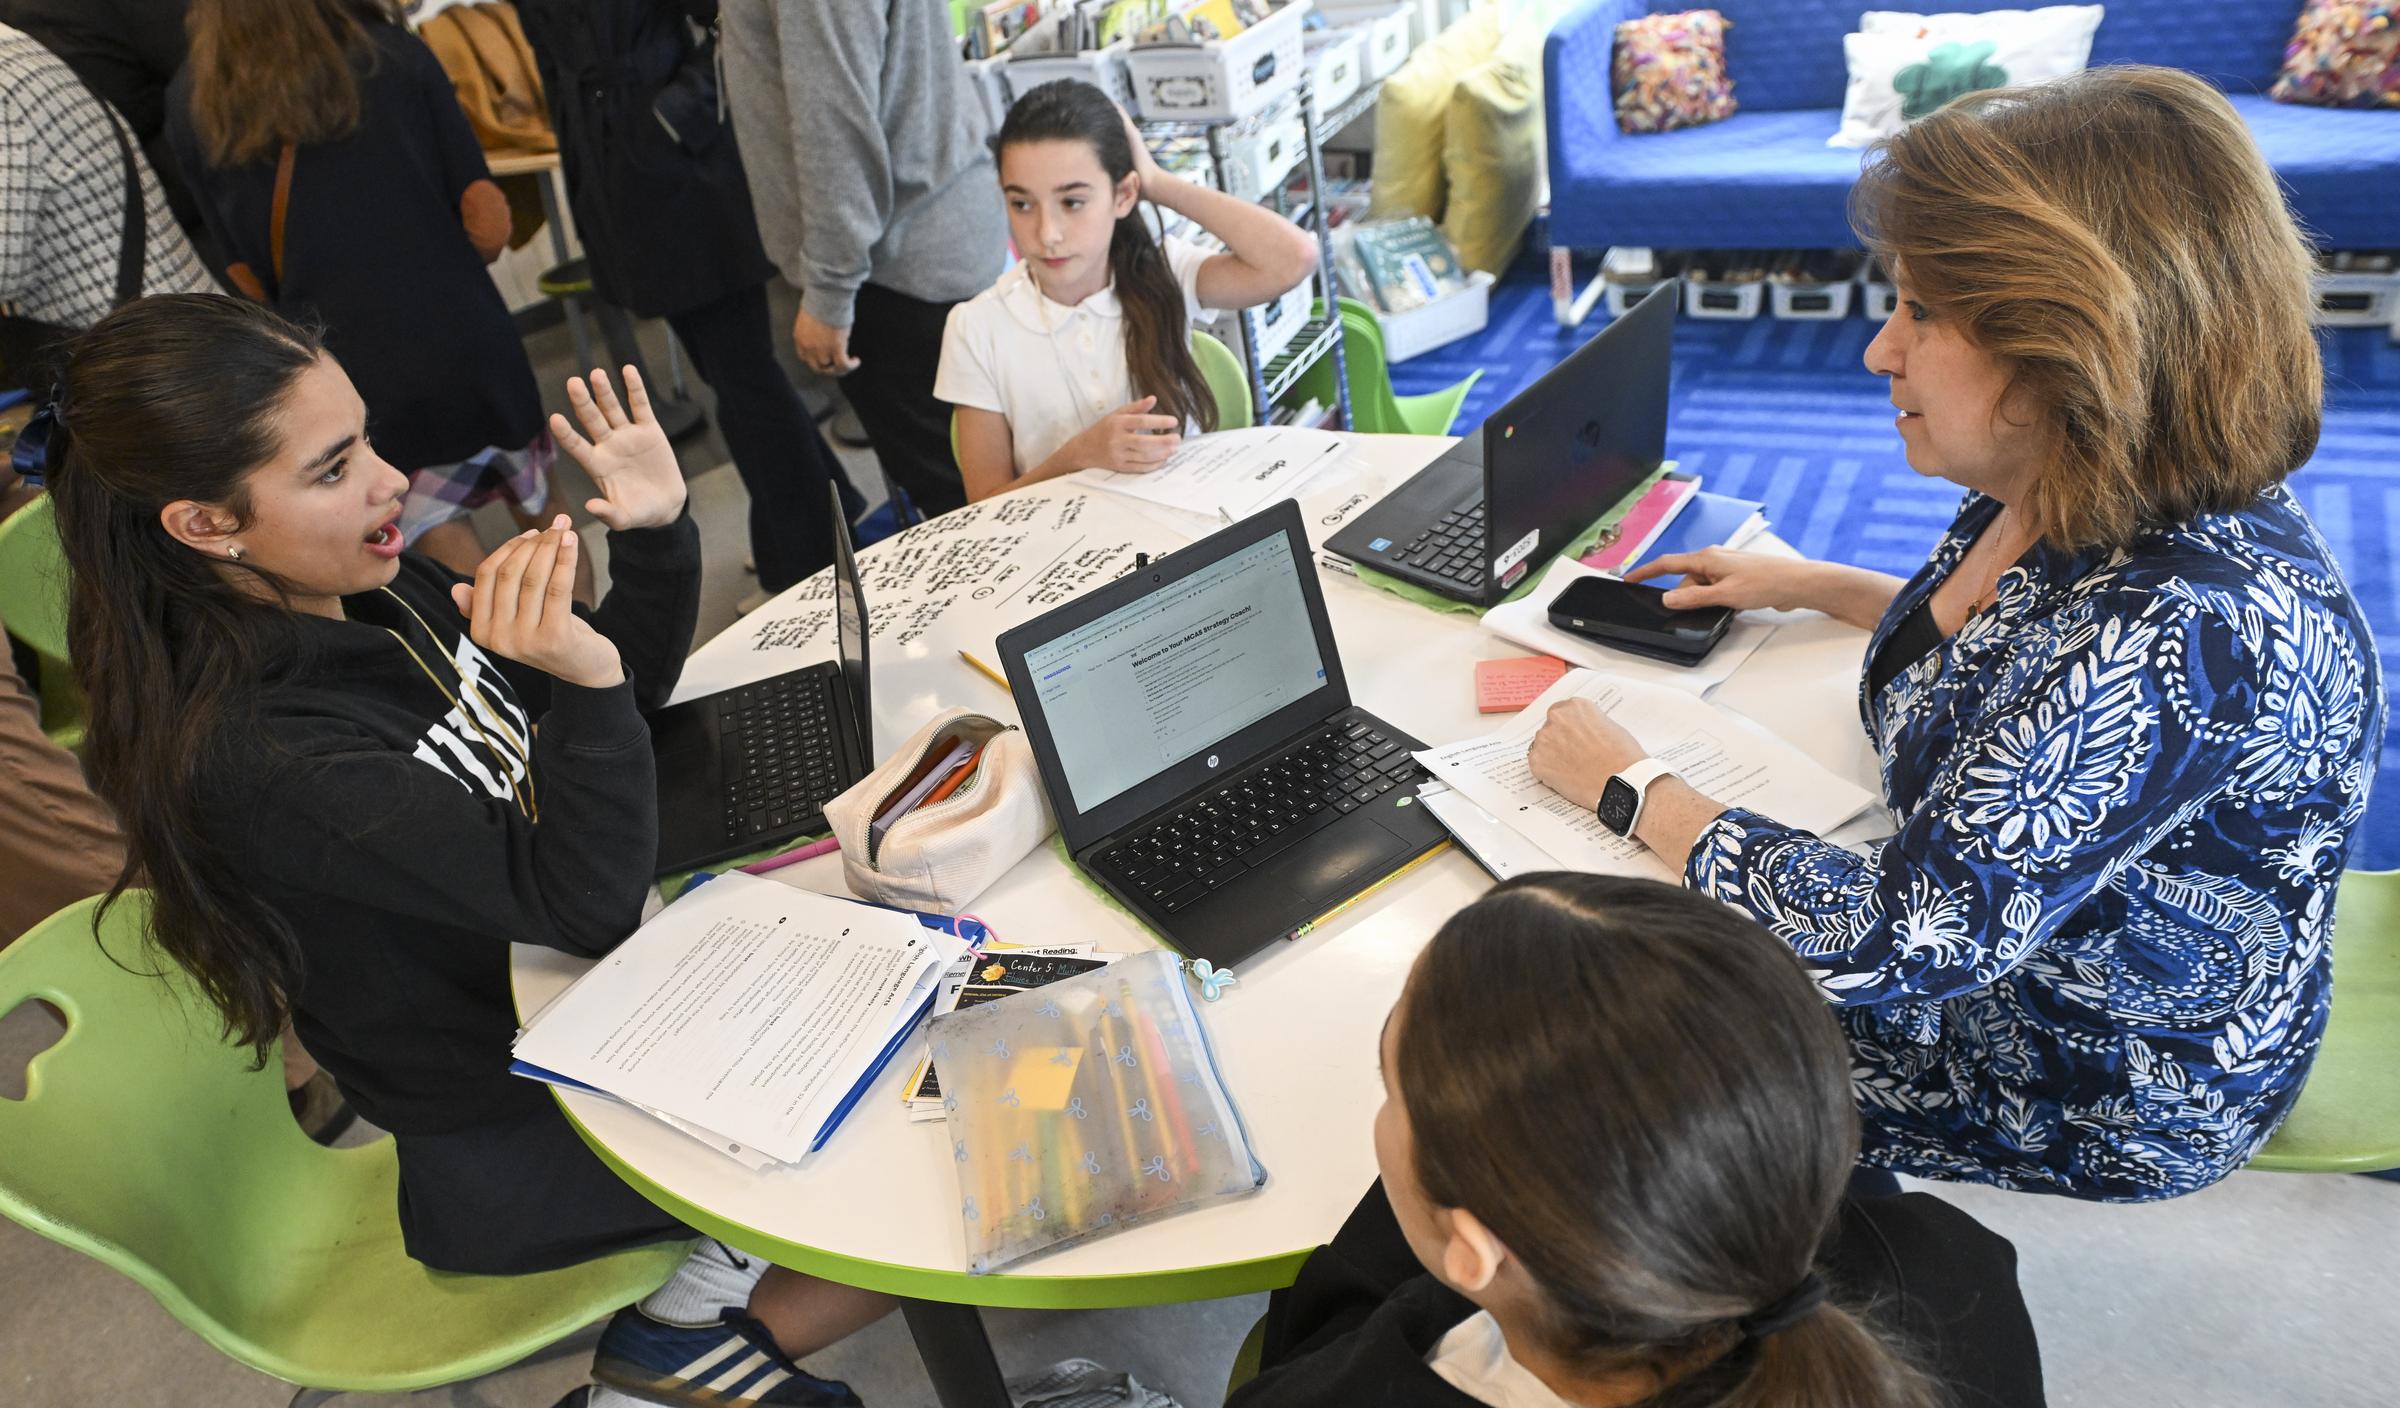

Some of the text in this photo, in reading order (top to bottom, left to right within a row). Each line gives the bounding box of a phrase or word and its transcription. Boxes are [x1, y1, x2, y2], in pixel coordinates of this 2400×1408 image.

[1131, 605, 1252, 668] Welcome to Your MCAS Strategy Coach!
[1042, 947, 1078, 956] Reading:
[1010, 959, 1043, 973] Center
[883, 944, 928, 1007] nglish Language Arts
[950, 984, 961, 995] F
